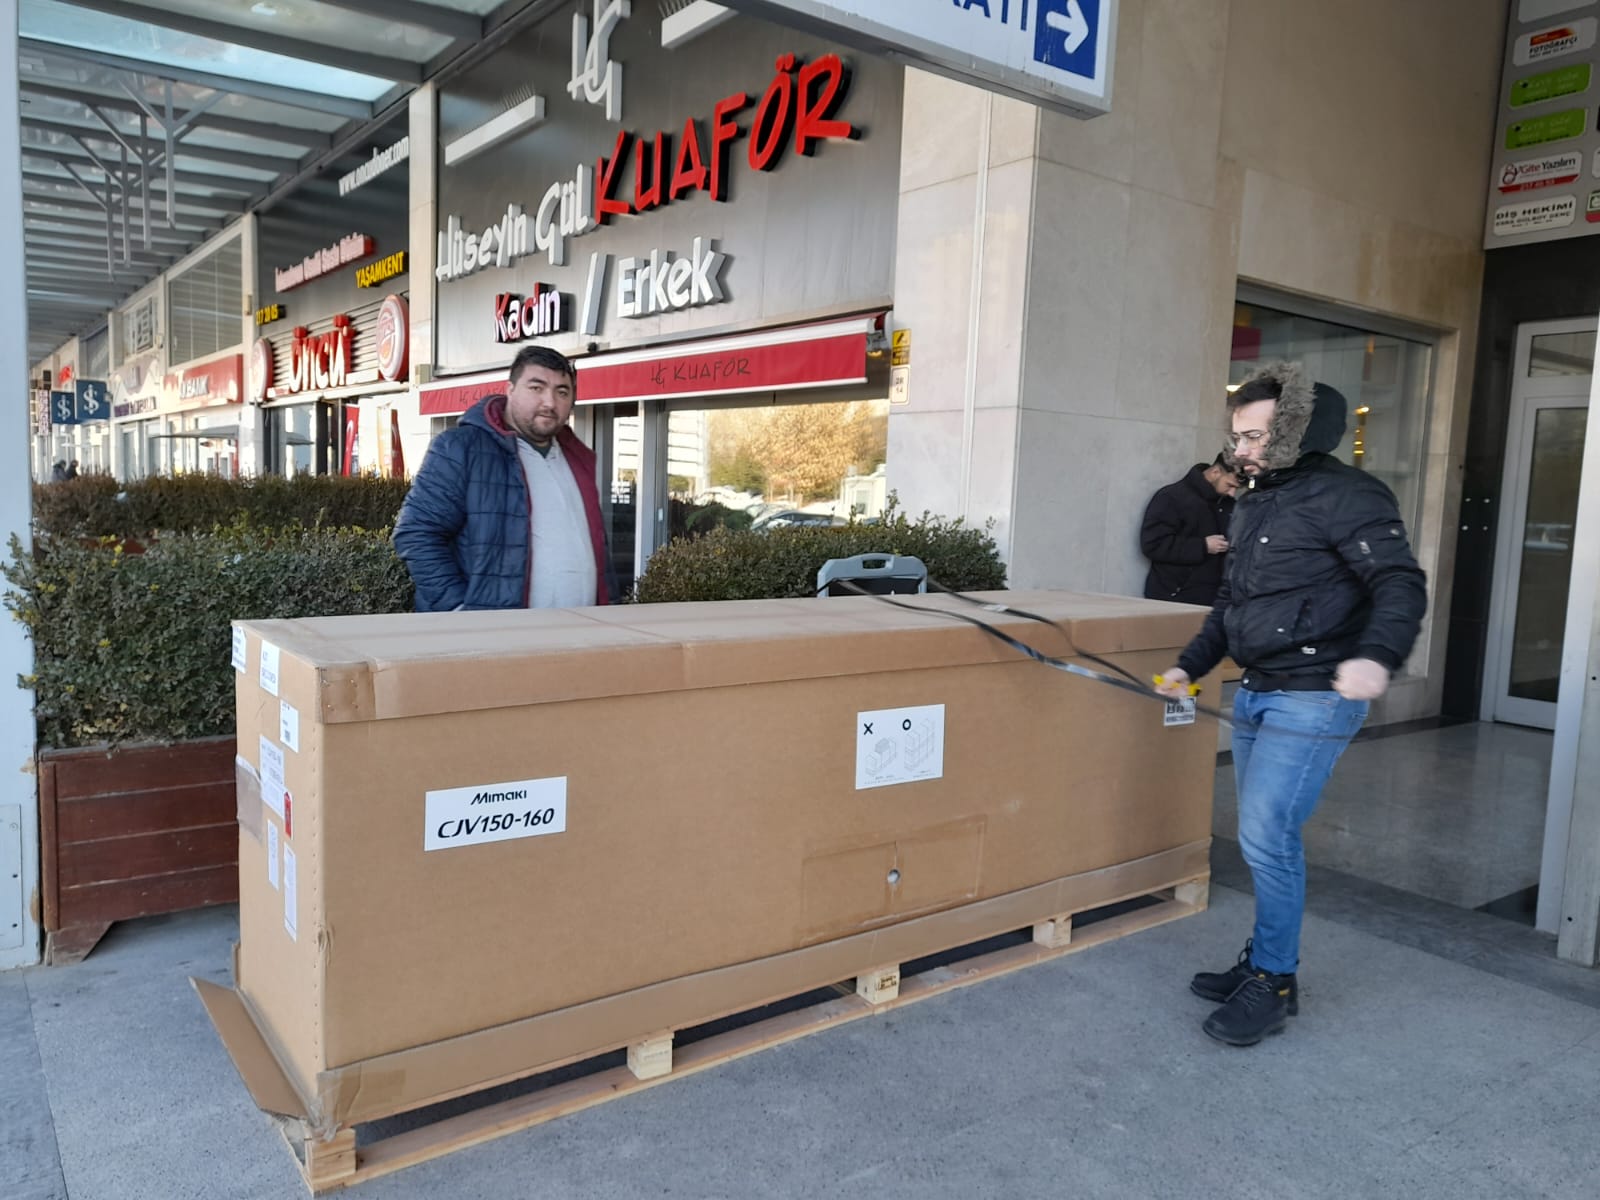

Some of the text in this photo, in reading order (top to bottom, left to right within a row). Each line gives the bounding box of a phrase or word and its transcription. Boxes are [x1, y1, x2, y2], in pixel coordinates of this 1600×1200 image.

[536, 163, 589, 265] Gül
[595, 53, 851, 225] KUAFÖR
[1522, 201, 1573, 215] HEKİMİ
[355, 250, 404, 288] YAŞAMKENT
[495, 282, 561, 342] Kadın
[617, 237, 718, 317] Erkek
[470, 790, 527, 806] Mimaki
[438, 808, 555, 839] CJV150-160
